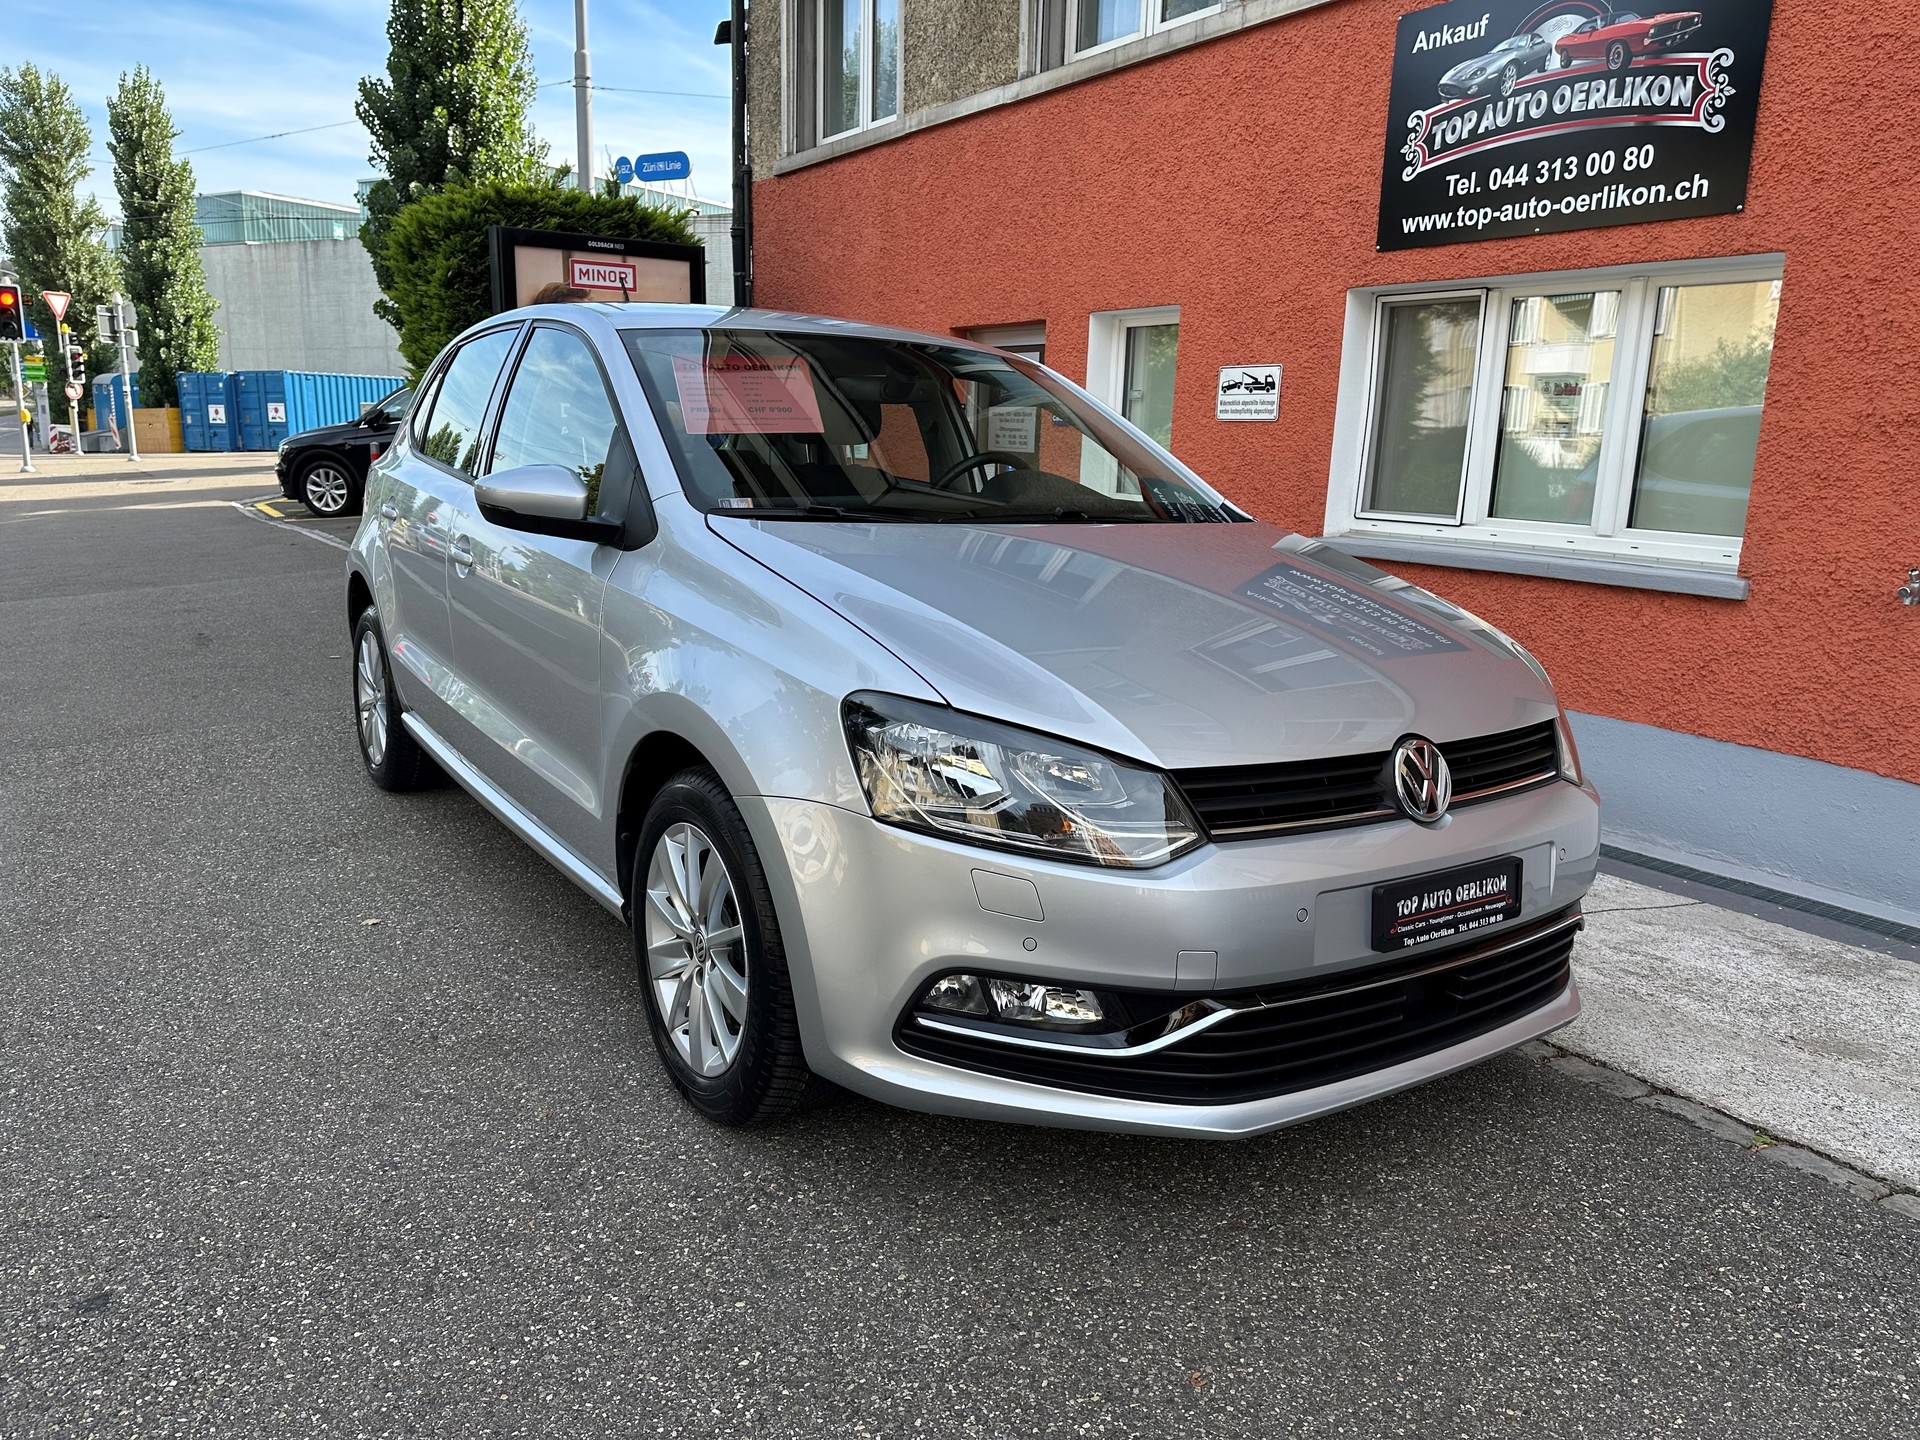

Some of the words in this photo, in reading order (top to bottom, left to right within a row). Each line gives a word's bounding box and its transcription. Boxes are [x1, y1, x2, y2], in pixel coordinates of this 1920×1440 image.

[1411, 13, 1491, 54] Ankauf
[1431, 111, 1476, 151] TOP
[1477, 92, 1546, 135] AUTO
[1552, 75, 1694, 115] OERLIKON
[643, 162, 656, 172] Züri
[666, 160, 681, 171] Linie
[1445, 172, 1481, 197] Tel.
[1489, 162, 1529, 190] 044
[1536, 156, 1578, 185] 313
[1585, 150, 1616, 177] 00
[1624, 143, 1655, 170] 80
[1401, 173, 1709, 234] www.top-auto-oerlikon.ch
[588, 240, 614, 249] GOLDBACH
[578, 267, 629, 284] MINOR
[708, 363, 741, 371] AUTO
[743, 364, 801, 372] OERLIKON
[1397, 895, 1418, 916] TOP
[1422, 889, 1452, 911] AUTO
[1456, 875, 1507, 902] OERLIKON
[1397, 924, 1415, 933] Classic
[1415, 921, 1426, 930] Cars
[1429, 914, 1454, 926] Youngtimer
[1457, 907, 1482, 918] Occasionen
[1403, 937, 1415, 946] Top
[1415, 934, 1430, 943] Auto
[1430, 928, 1455, 940] Oerlikon
[1458, 923, 1467, 932] Tel.
[1469, 920, 1479, 930] 044
[1479, 917, 1489, 927] 313
[1489, 915, 1496, 924] 00
[1496, 913, 1504, 922] 80
